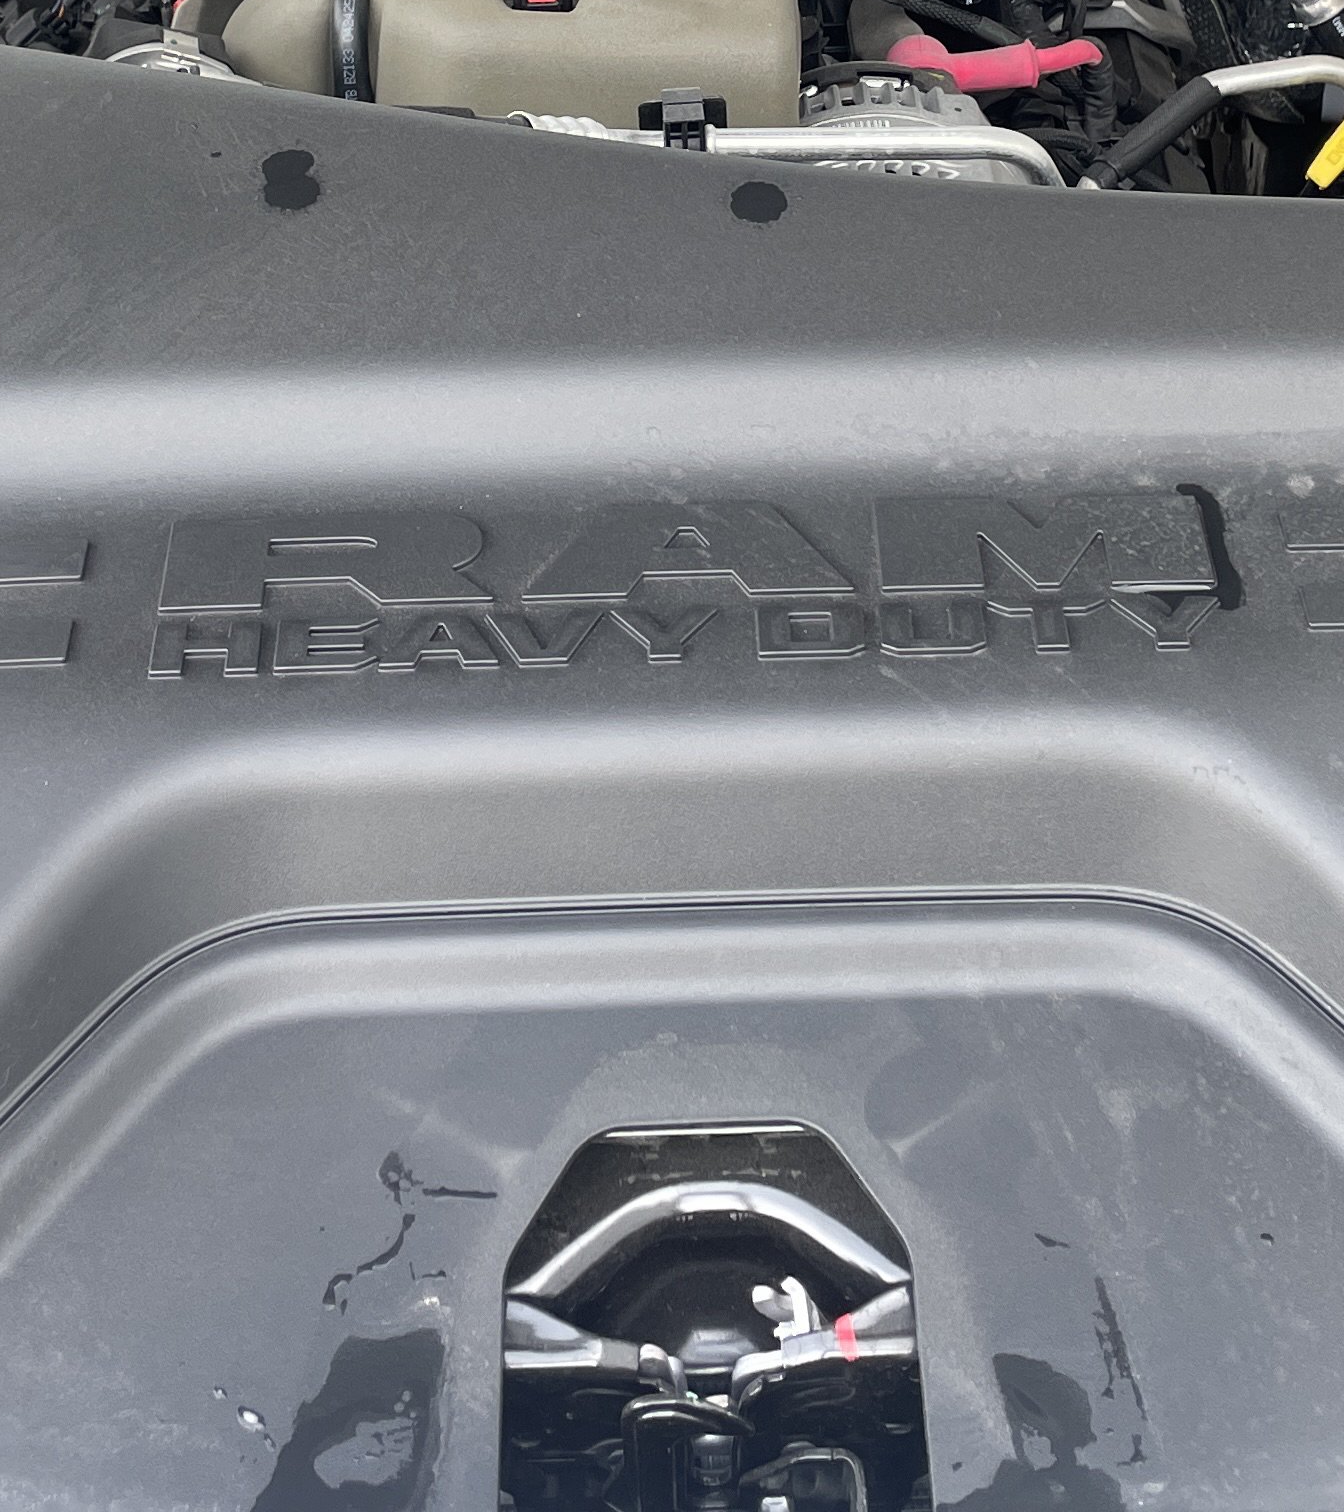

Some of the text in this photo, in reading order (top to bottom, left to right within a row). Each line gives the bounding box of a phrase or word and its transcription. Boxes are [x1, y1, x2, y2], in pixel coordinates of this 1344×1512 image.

[157, 492, 1220, 614] RAM
[148, 588, 1222, 679] HEAVY DUTY
